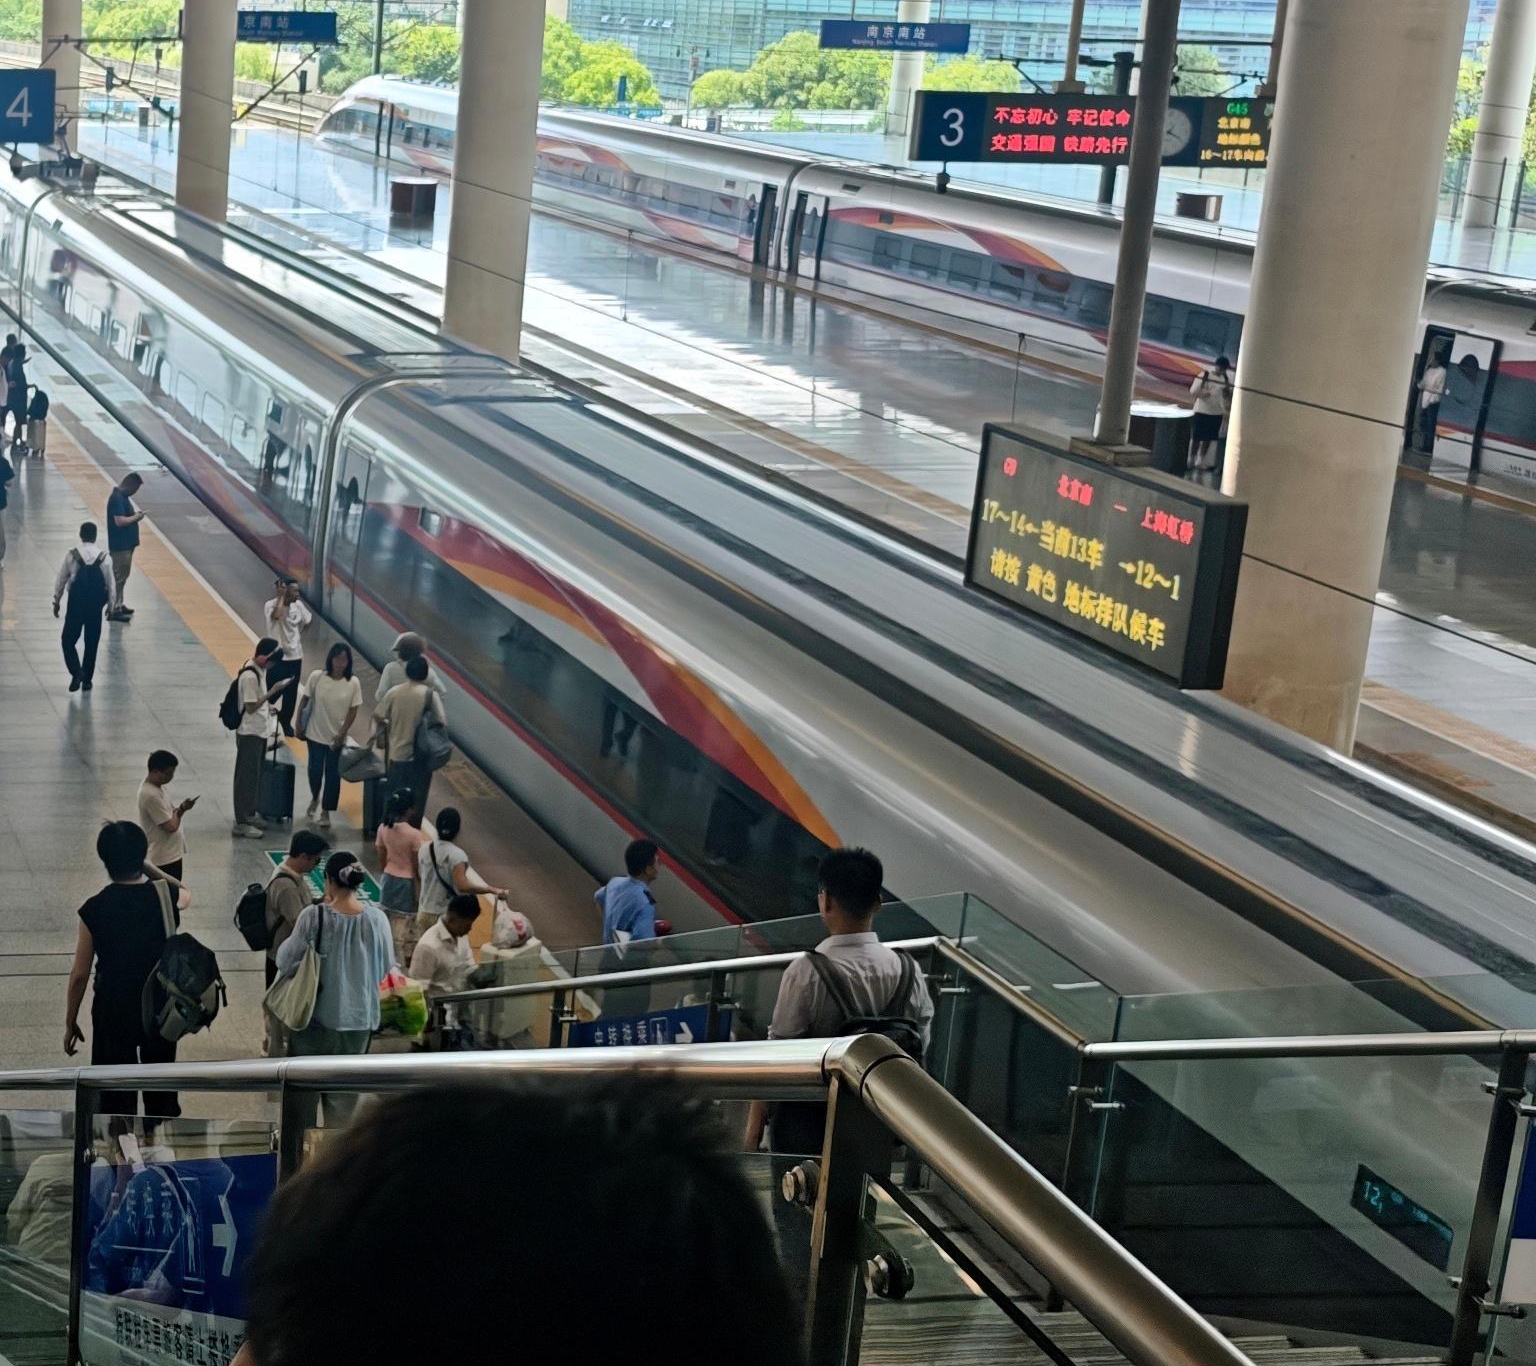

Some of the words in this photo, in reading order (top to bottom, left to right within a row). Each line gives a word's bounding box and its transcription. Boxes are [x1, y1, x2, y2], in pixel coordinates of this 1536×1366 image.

[866, 25, 926, 40] 南京南站
[6, 86, 33, 128] 4
[939, 107, 965, 148] 3
[994, 106, 1059, 126] 不忘初心
[1066, 108, 1131, 127] 牢记使命
[990, 133, 1057, 152] 交通强国
[1064, 135, 1130, 154] 铁路先行
[1057, 474, 1095, 506] 北京南
[1140, 506, 1195, 545] 上海虹桥
[990, 547, 1021, 586] 请按
[1025, 561, 1057, 604] 黄色
[1063, 580, 1166, 651] 地标排队候车
